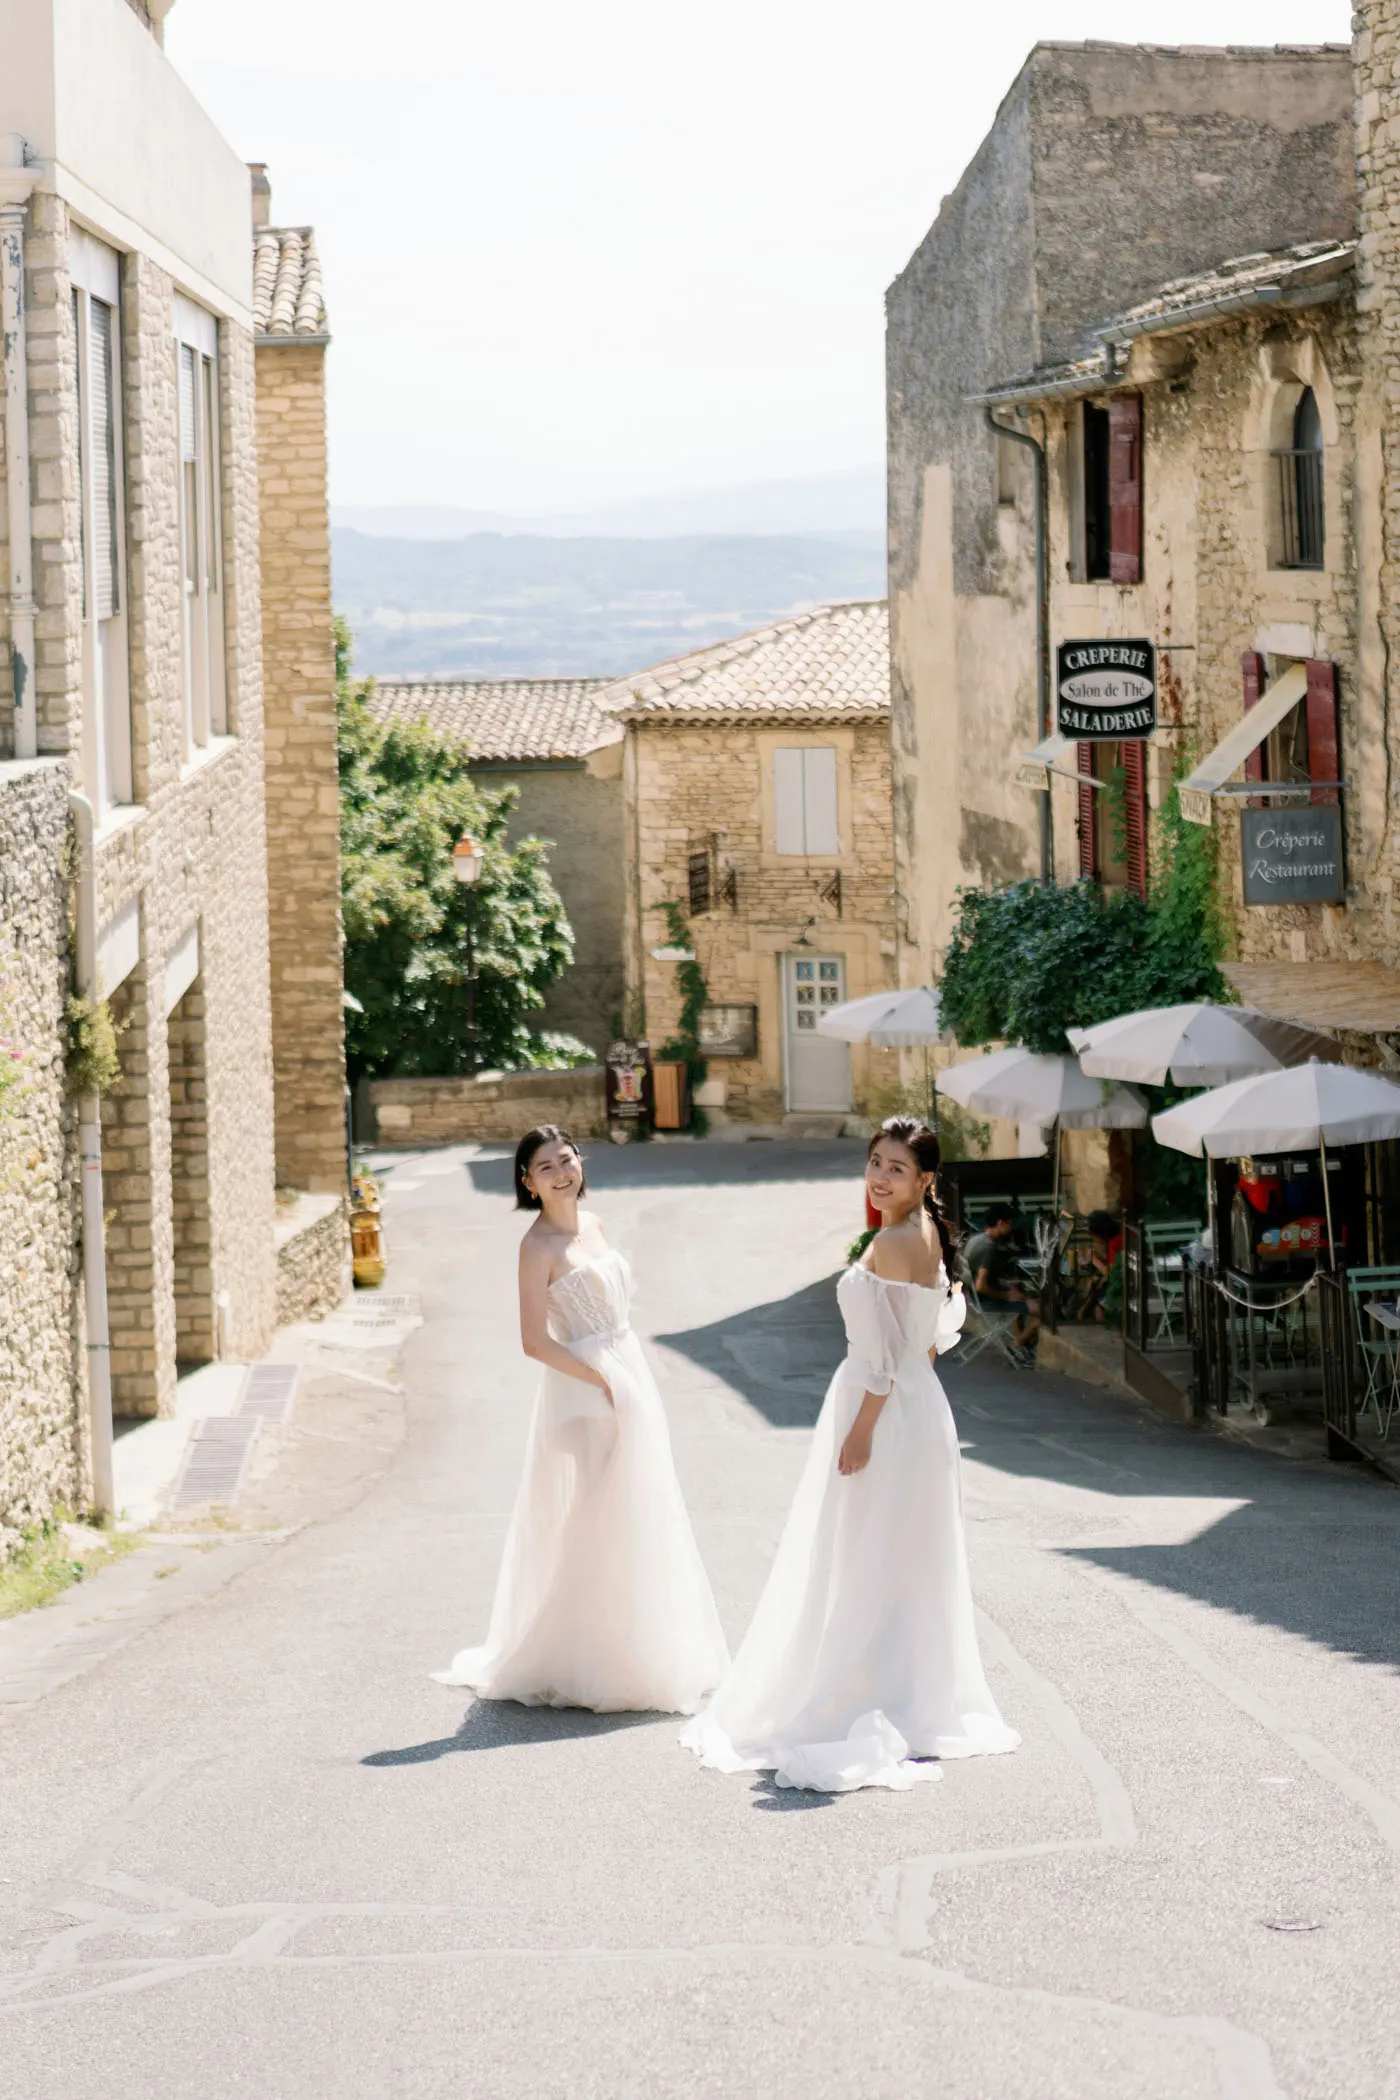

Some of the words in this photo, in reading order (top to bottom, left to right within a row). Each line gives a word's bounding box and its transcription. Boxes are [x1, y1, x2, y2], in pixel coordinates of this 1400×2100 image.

[1065, 646, 1148, 670] CREPERIE
[1068, 681, 1100, 698] Salon
[1105, 681, 1118, 697] de
[1122, 681, 1146, 697] Thé
[1061, 708, 1154, 732] SALADERIE
[1256, 829, 1325, 856] Crêperie
[1248, 860, 1336, 884] Restaurant
